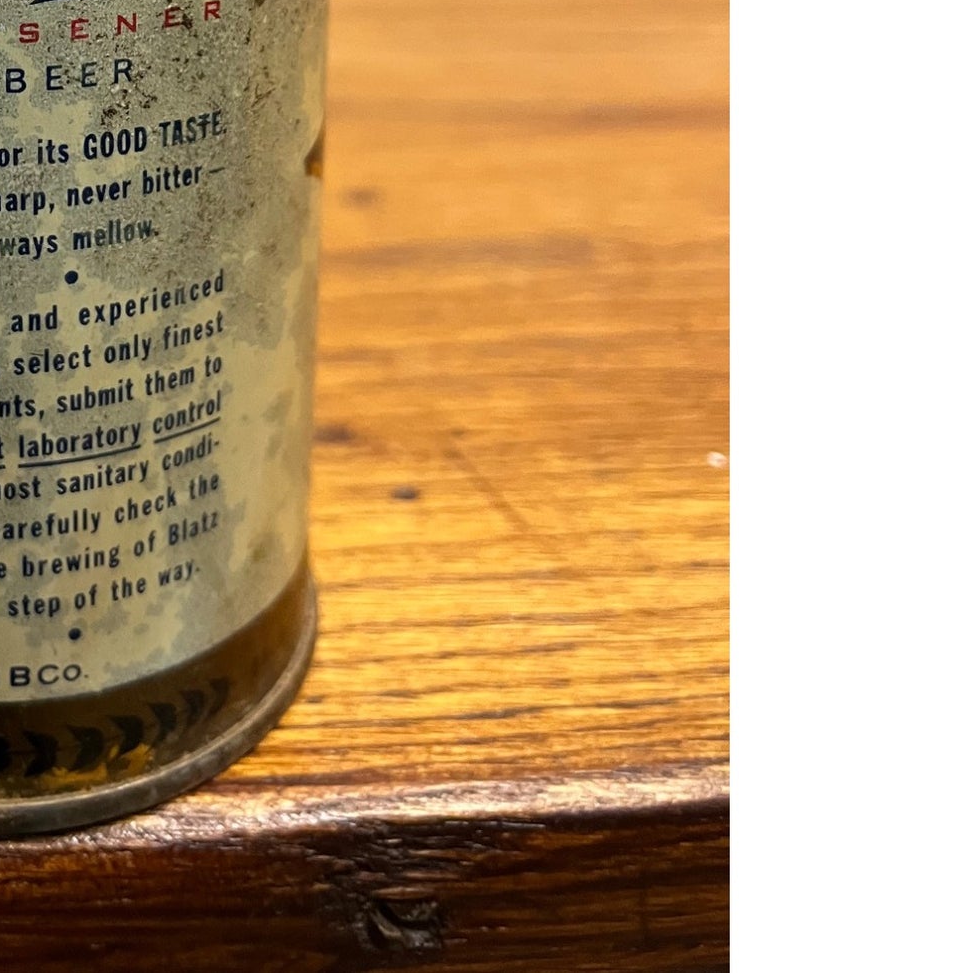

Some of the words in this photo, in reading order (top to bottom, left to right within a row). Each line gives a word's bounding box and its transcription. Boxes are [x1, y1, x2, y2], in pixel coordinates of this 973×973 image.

[5, 58, 133, 93] BEER
[37, 139, 69, 164] its
[83, 126, 147, 160] GOOD
[159, 110, 228, 147] TASTE.
[67, 179, 131, 207] never
[72, 219, 160, 251] mellow.
[11, 305, 58, 332] and
[79, 268, 224, 326] experienced
[13, 344, 92, 377] select
[104, 333, 152, 362] only
[163, 310, 224, 351] finest
[57, 379, 134, 414] submit
[145, 366, 195, 396] them
[204, 355, 222, 378] to
[19, 422, 141, 459] laboratory
[153, 390, 221, 435] control
[56, 460, 149, 495] sanitary
[162, 432, 220, 471] condi-
[115, 486, 176, 523] check
[189, 473, 220, 500] the
[22, 544, 120, 577] brewing
[133, 530, 156, 557] of
[168, 511, 219, 547] Blatz
[8, 594, 61, 618] step
[74, 584, 97, 609] of
[111, 577, 147, 602] the
[158, 559, 201, 587] way.
